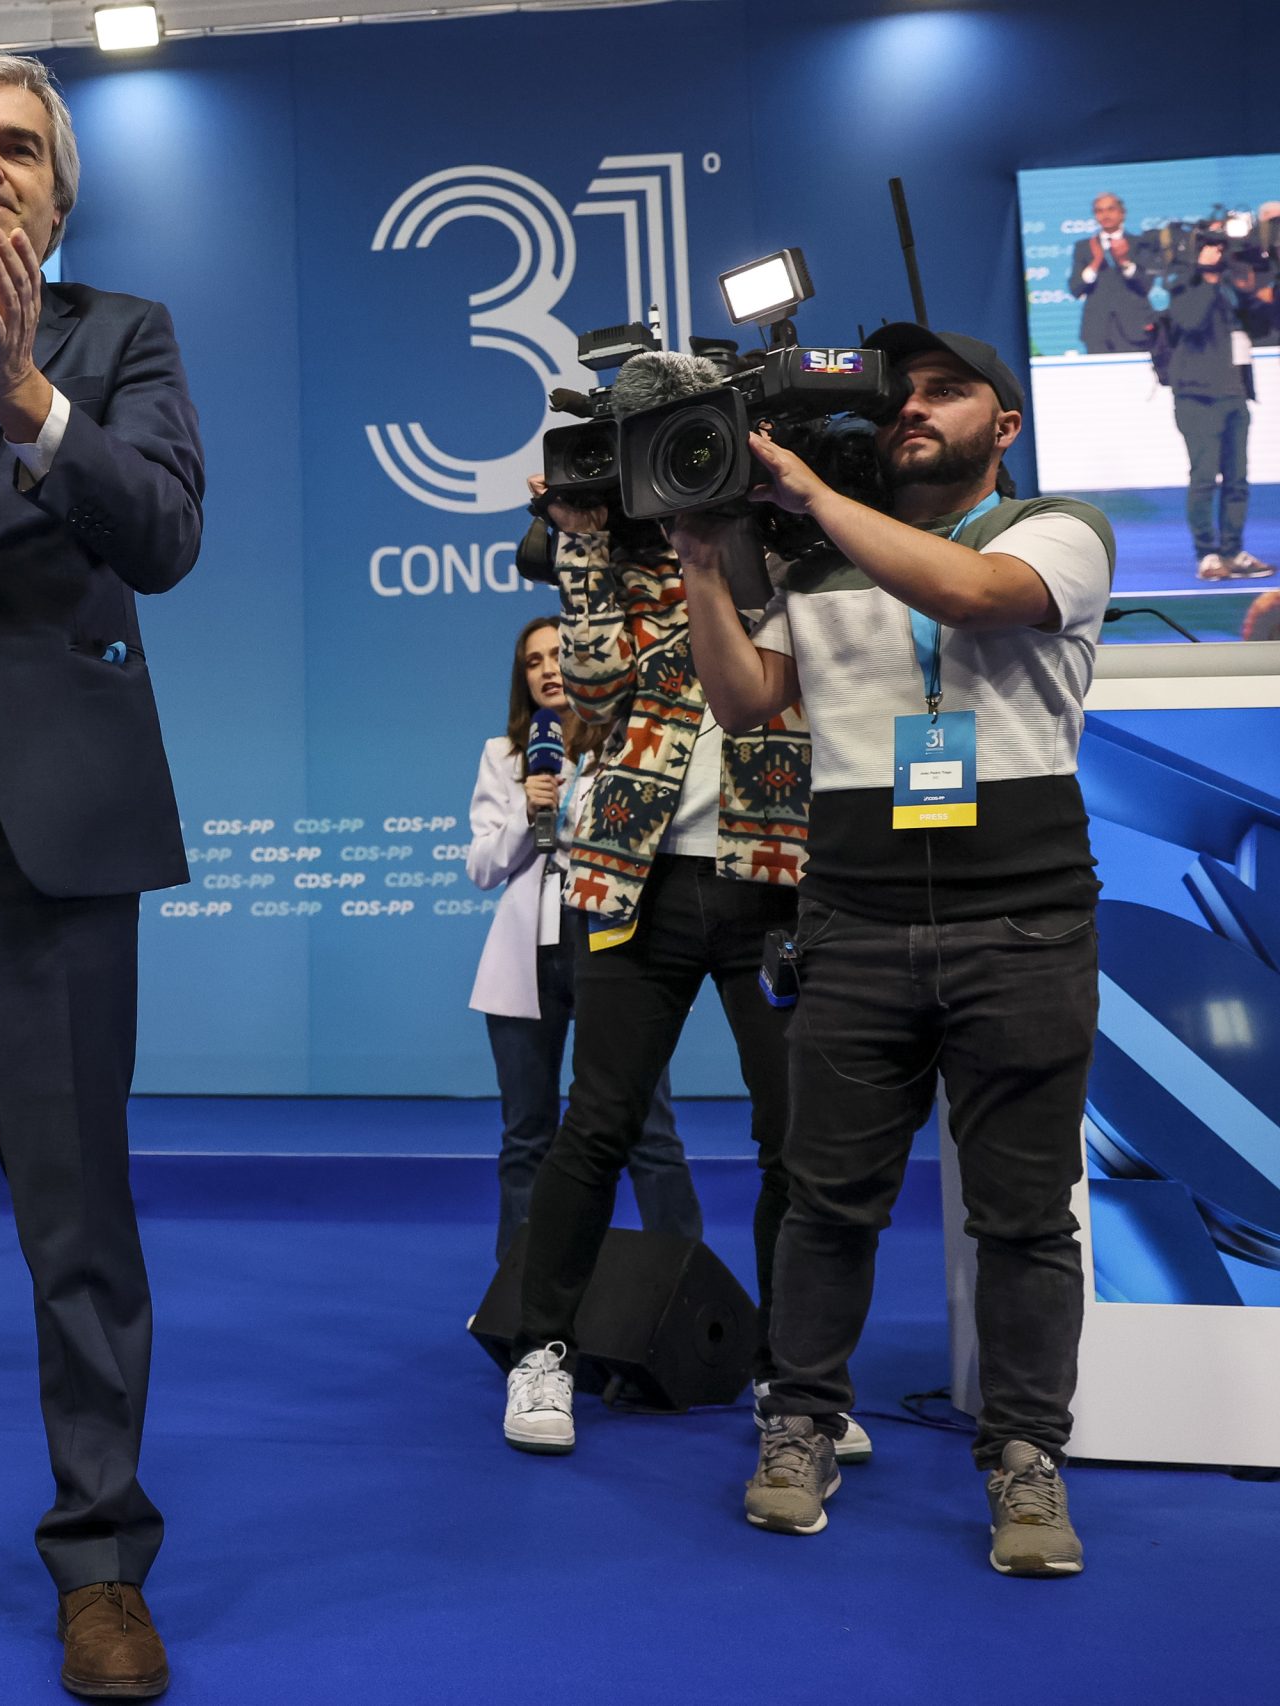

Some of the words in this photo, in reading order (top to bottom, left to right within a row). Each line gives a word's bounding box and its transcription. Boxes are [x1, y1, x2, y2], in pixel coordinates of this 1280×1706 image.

[370, 541, 526, 597] CONG
[925, 728, 944, 748] 31
[203, 819, 274, 835] CDS-PP
[293, 818, 364, 834] CDS-PP
[383, 816, 457, 832] CDS-PP
[919, 813, 949, 821] PRESS
[250, 846, 321, 862] CDS-PP
[340, 845, 413, 861] CDS-PP
[203, 873, 274, 889] CDS-PP
[294, 872, 365, 888] CDS-PP
[384, 871, 457, 887] CDS-PP
[160, 901, 231, 917] CDS-PP
[250, 901, 322, 916] CDS-PP
[341, 900, 414, 916] CDS-PP
